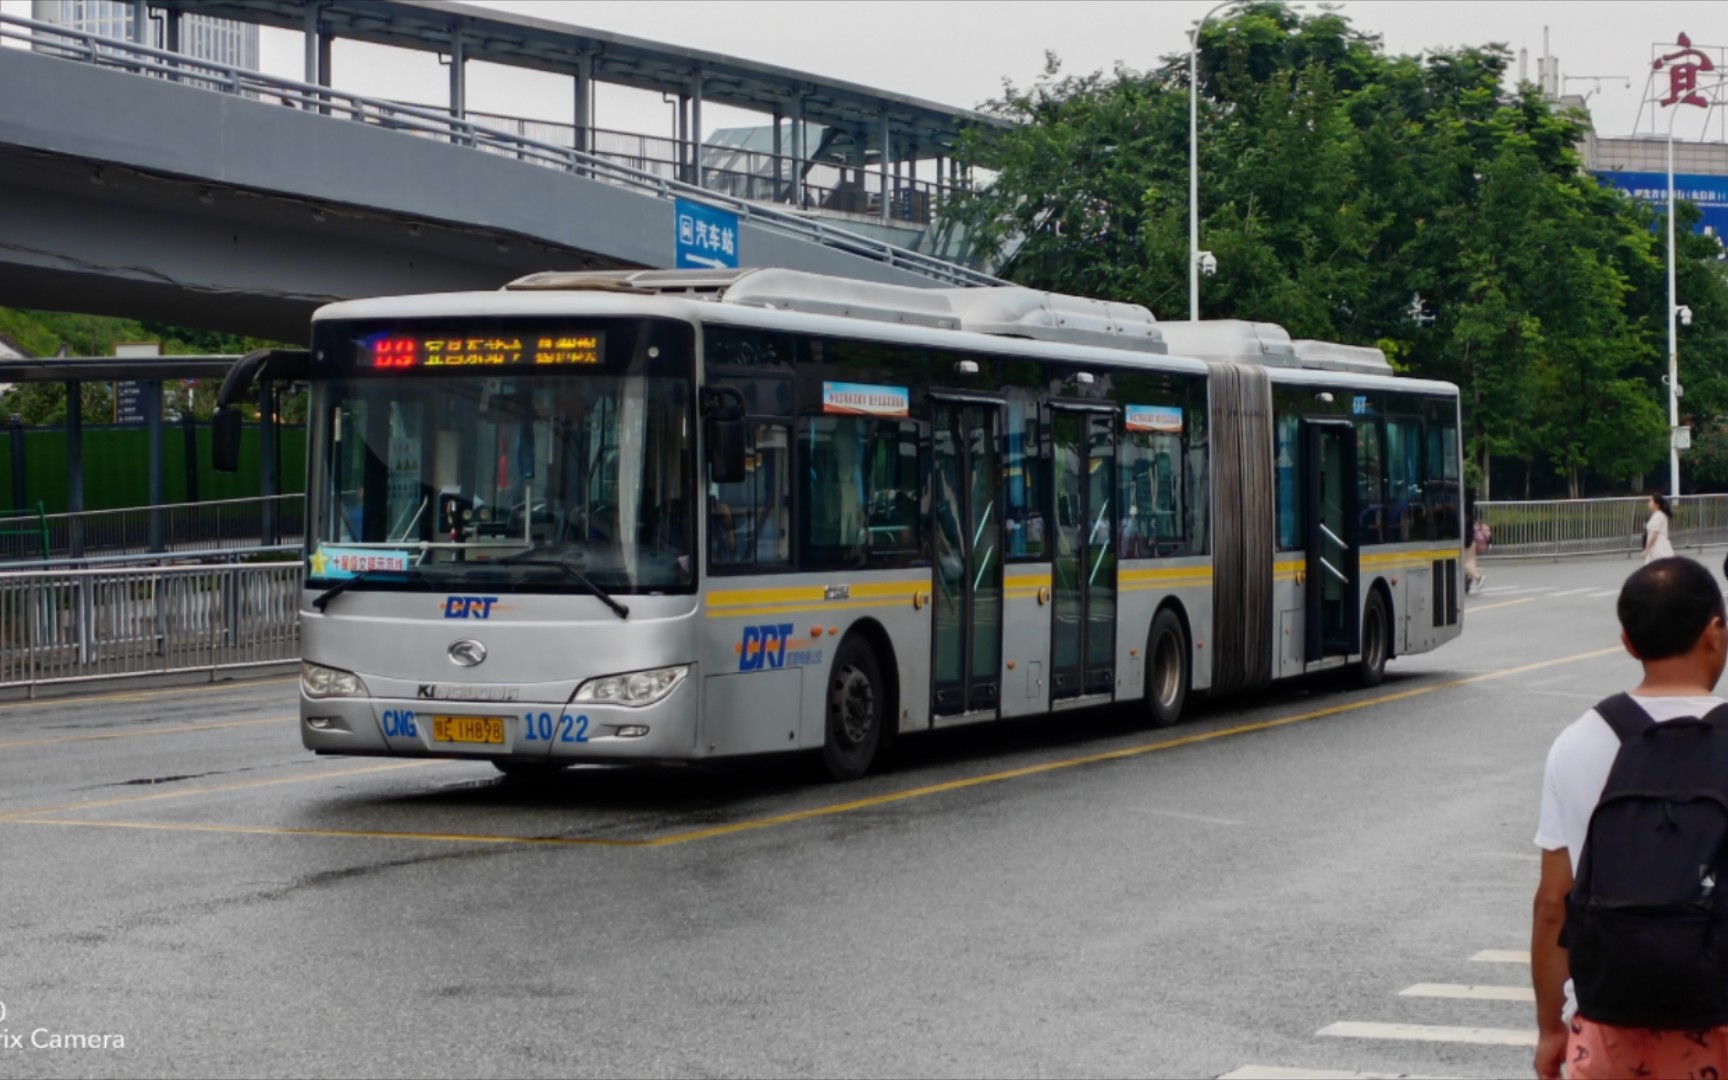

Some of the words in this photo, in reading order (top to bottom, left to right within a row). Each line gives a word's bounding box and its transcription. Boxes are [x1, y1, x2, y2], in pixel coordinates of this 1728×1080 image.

[1653, 31, 1714, 108] 宜
[695, 219, 735, 256] 汽车站
[383, 711, 417, 738] CNG
